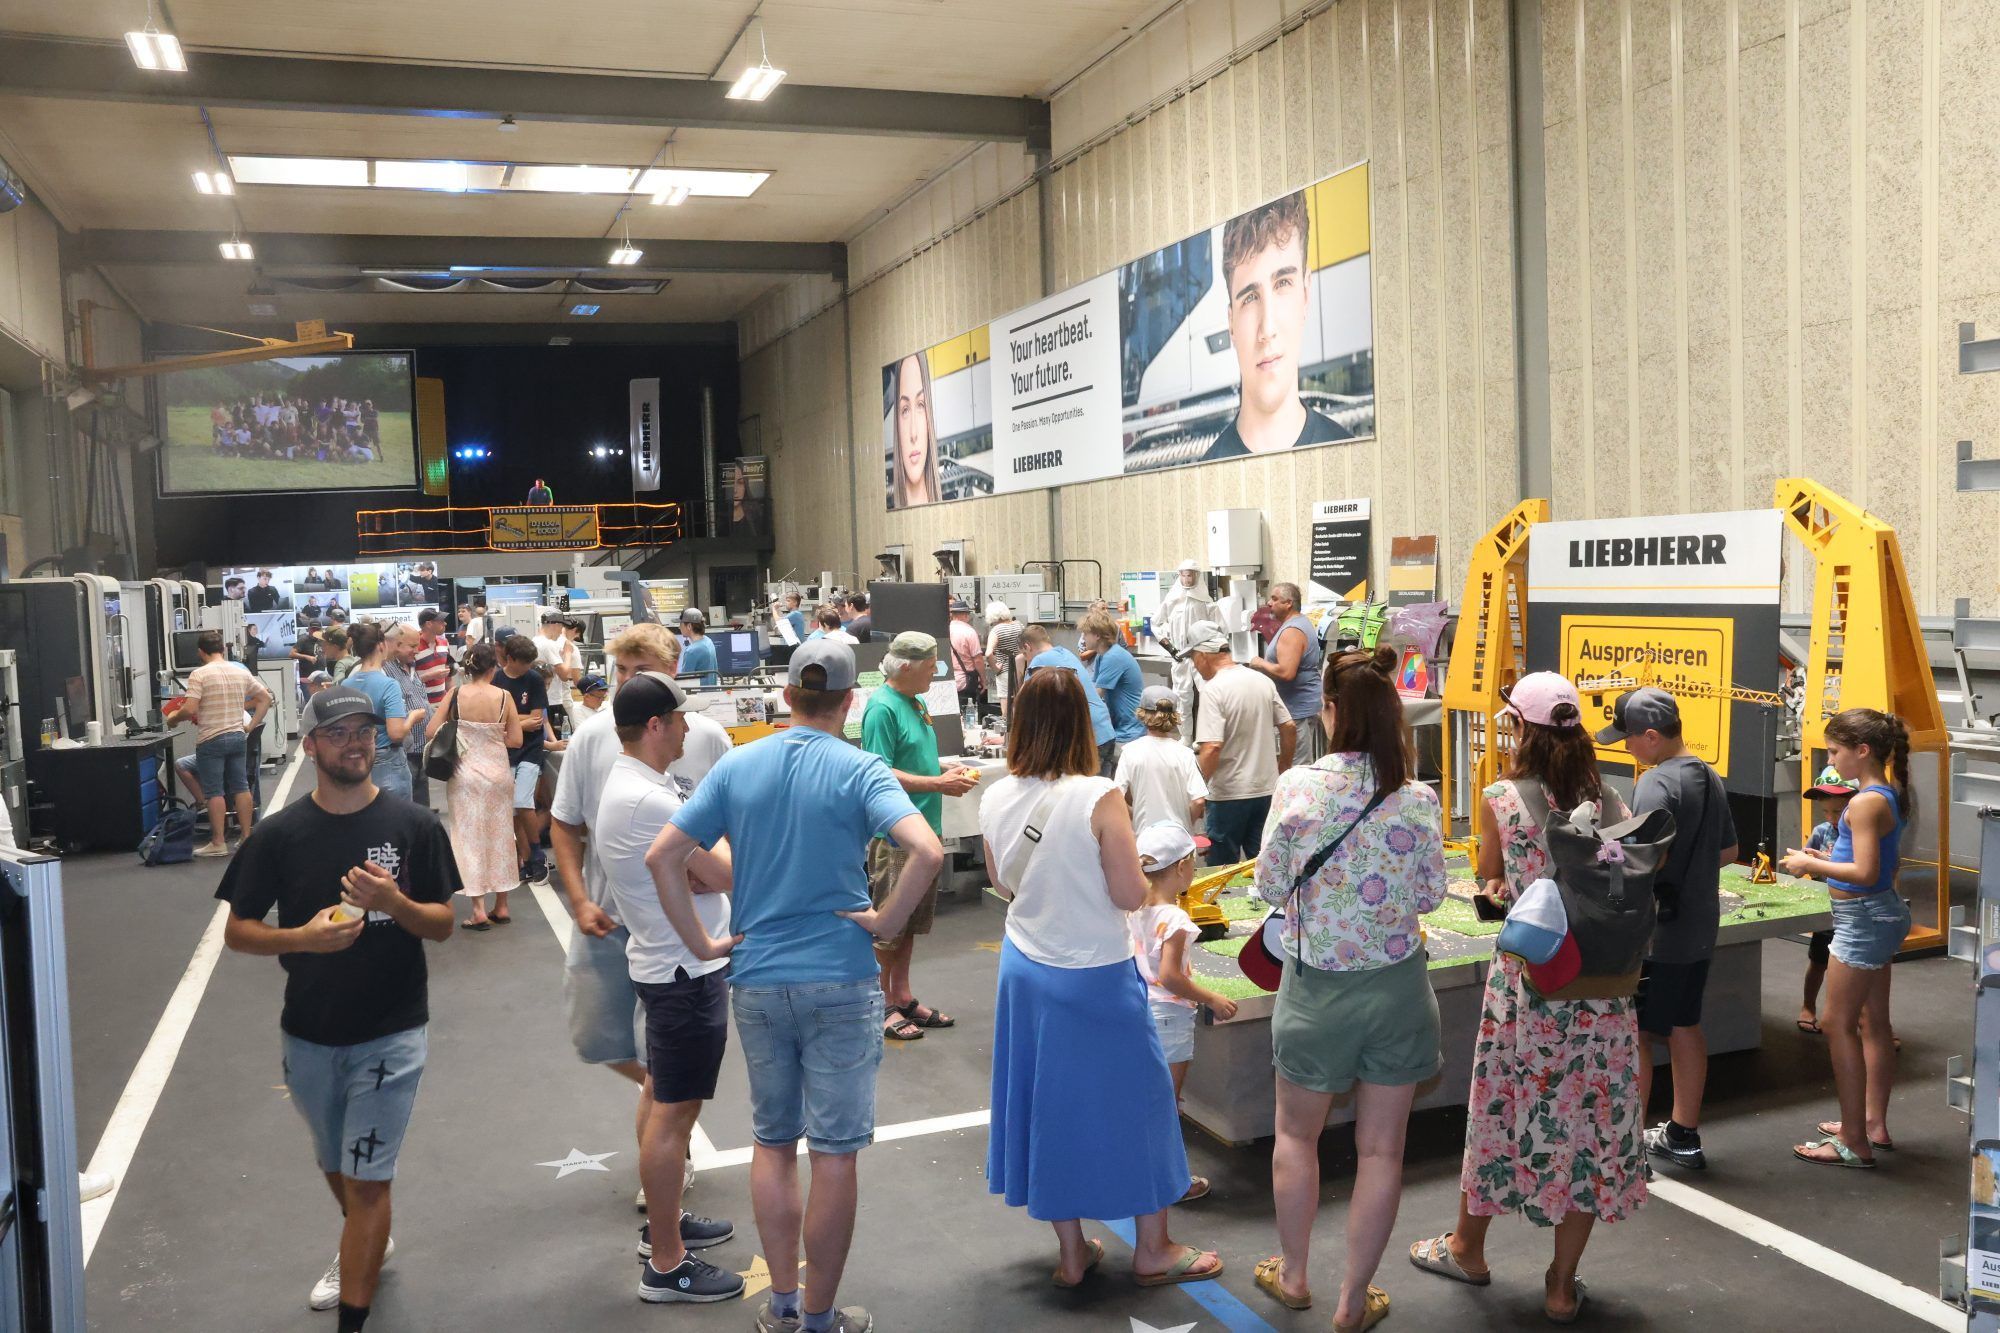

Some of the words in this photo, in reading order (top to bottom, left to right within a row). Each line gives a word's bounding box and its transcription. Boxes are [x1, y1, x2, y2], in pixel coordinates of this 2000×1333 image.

[1010, 340, 1033, 364] Your
[1035, 314, 1092, 357] heartbeat.
[1011, 371, 1034, 395] Your
[1035, 360, 1072, 389] future.
[1012, 421, 1021, 432] One
[1020, 418, 1038, 431] Passion.
[1039, 415, 1051, 428] Many
[1051, 406, 1085, 425] Opportunities.
[642, 402, 651, 471] LIEBHERR
[1013, 449, 1063, 473] LIEBHERR
[1323, 503, 1358, 514] LIEBHERR
[1569, 534, 1727, 567] LIEBHERR
[1472, 571, 1493, 692] LIEBHERR
[1580, 639, 1708, 667] Ausprobieren
[326, 696, 367, 707] LIEBHERR
